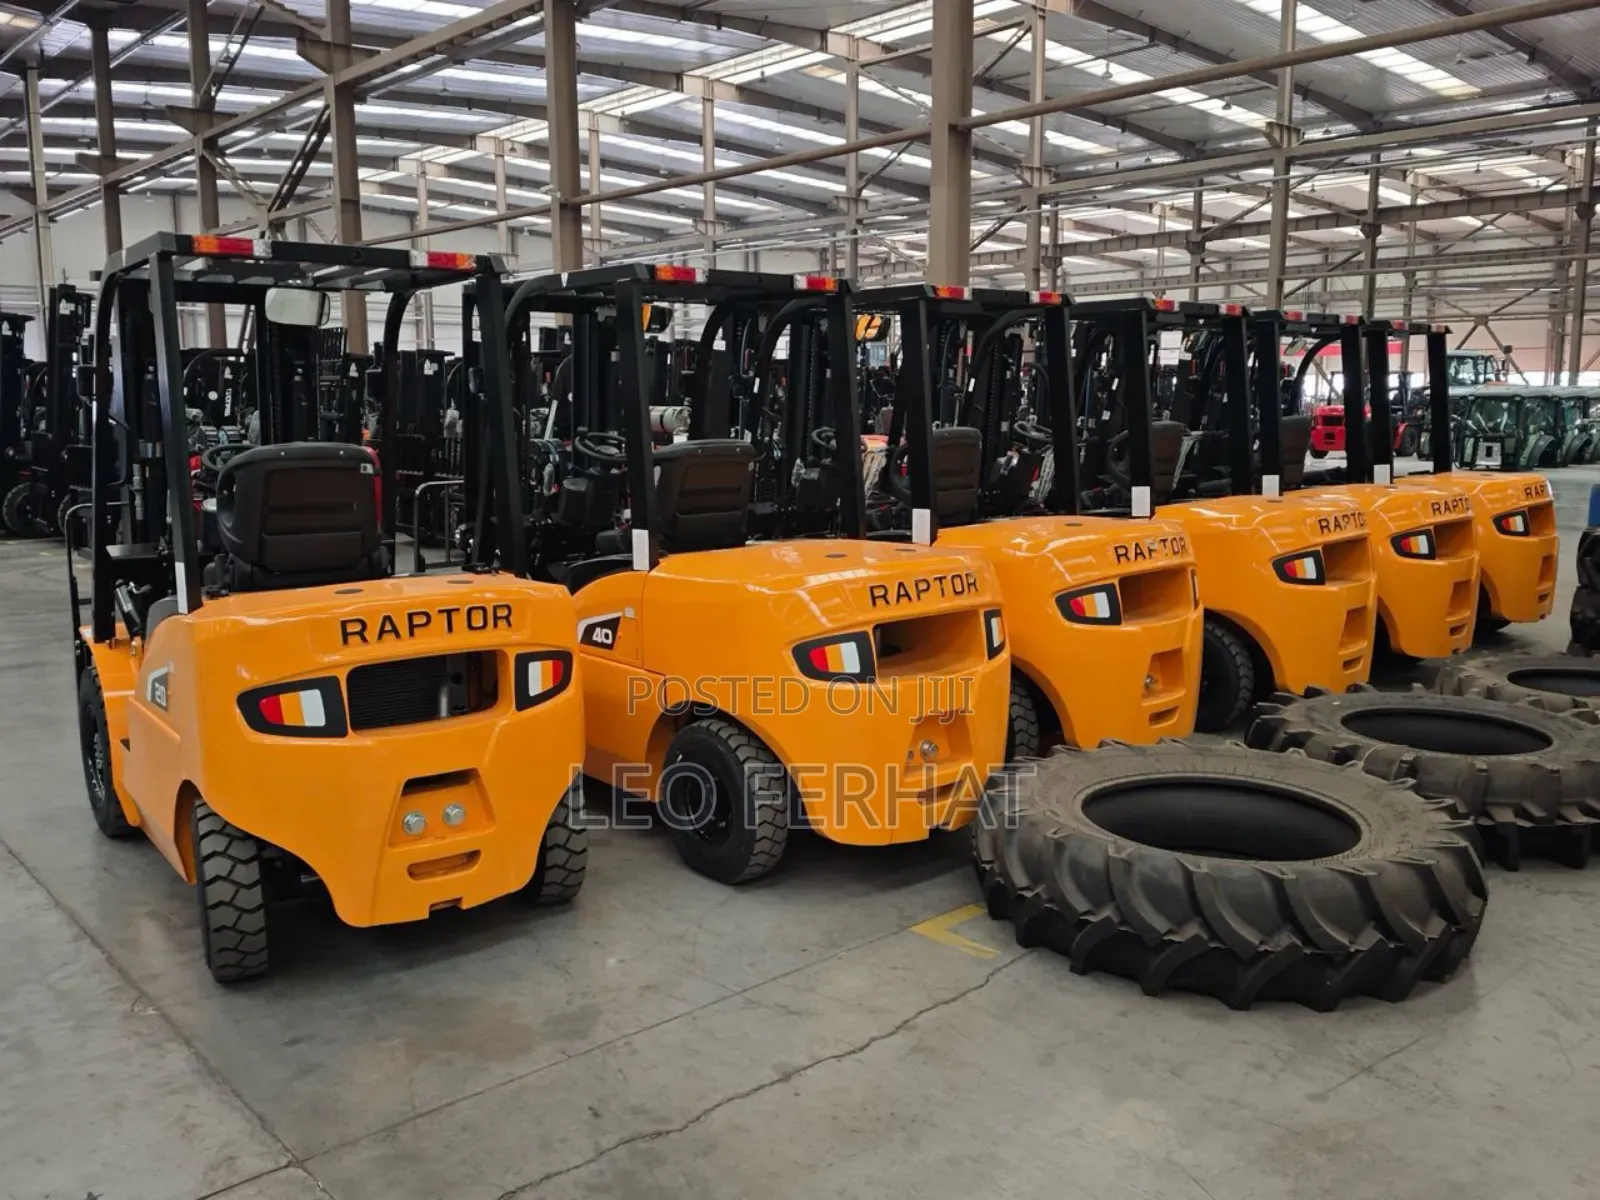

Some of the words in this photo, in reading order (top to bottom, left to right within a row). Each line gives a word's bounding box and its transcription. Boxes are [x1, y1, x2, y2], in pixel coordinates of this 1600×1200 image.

[1524, 484, 1545, 500] RAP
[1431, 497, 1470, 516] RAPT
[1318, 511, 1367, 535] RAPTO
[869, 571, 978, 607] RAPTOR
[339, 603, 513, 646] RAPTOR
[592, 627, 613, 645] 40
